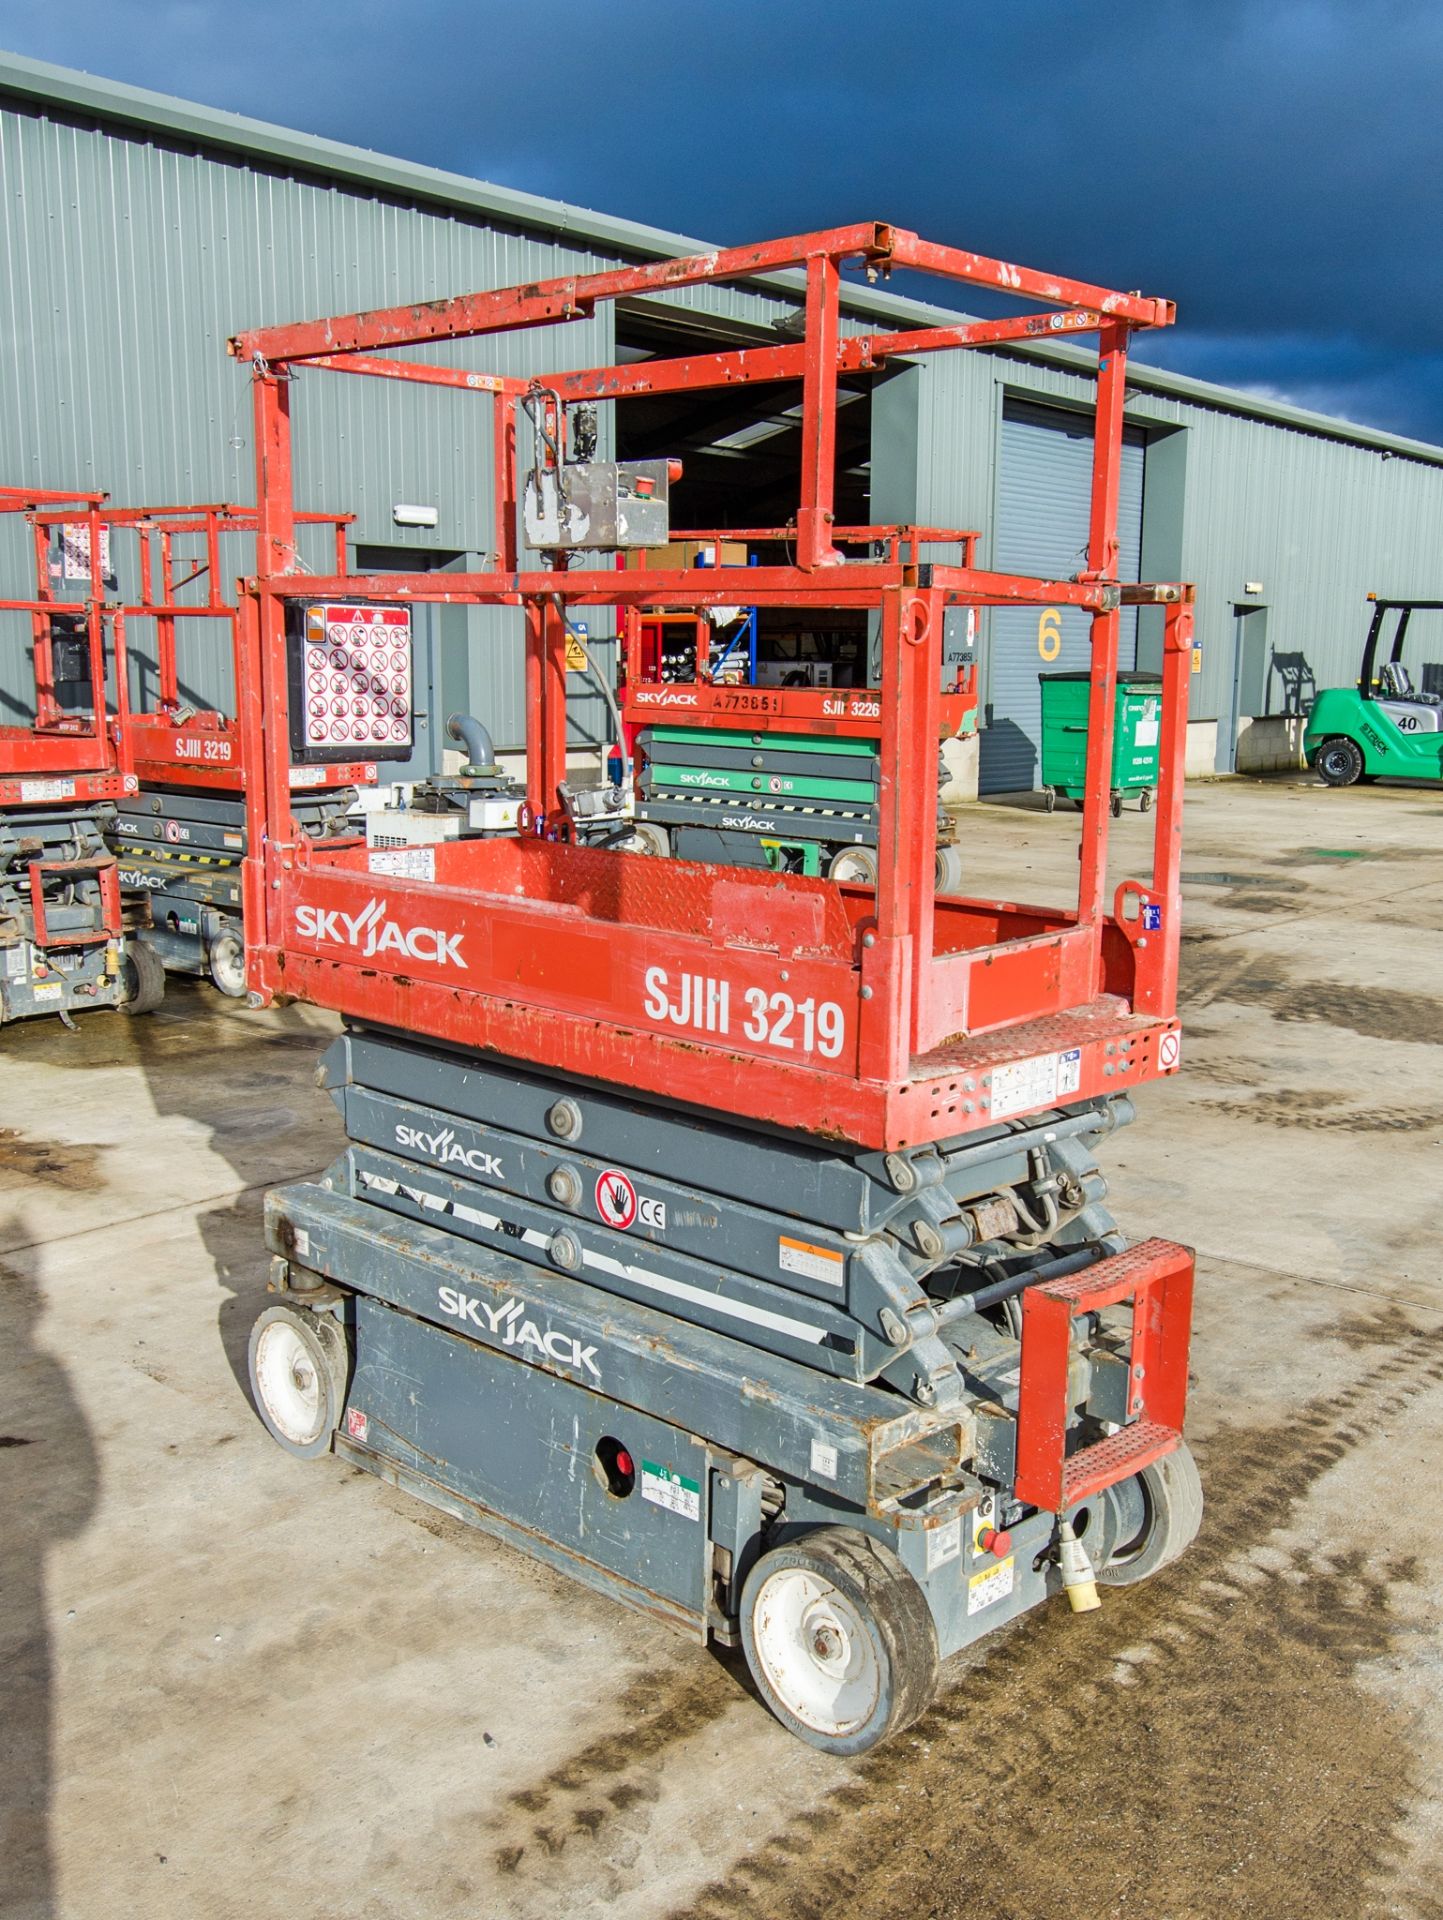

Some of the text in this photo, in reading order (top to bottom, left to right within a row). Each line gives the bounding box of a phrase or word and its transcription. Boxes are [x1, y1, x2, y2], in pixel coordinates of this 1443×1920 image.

[1038, 607, 1061, 662] 6
[636, 688, 698, 706] SKYJACK
[851, 702, 880, 716] 3226
[1398, 717, 1417, 730] 40
[204, 741, 232, 761] 3219
[680, 771, 730, 787] SKYJACK
[721, 815, 775, 831] SKYJACK
[295, 897, 469, 970] SKYJACK
[644, 966, 846, 1060] SJIII 3219
[395, 1124, 505, 1179] SKYJACK
[640, 1199, 665, 1227] CE
[438, 1285, 603, 1378] SKYJACK
